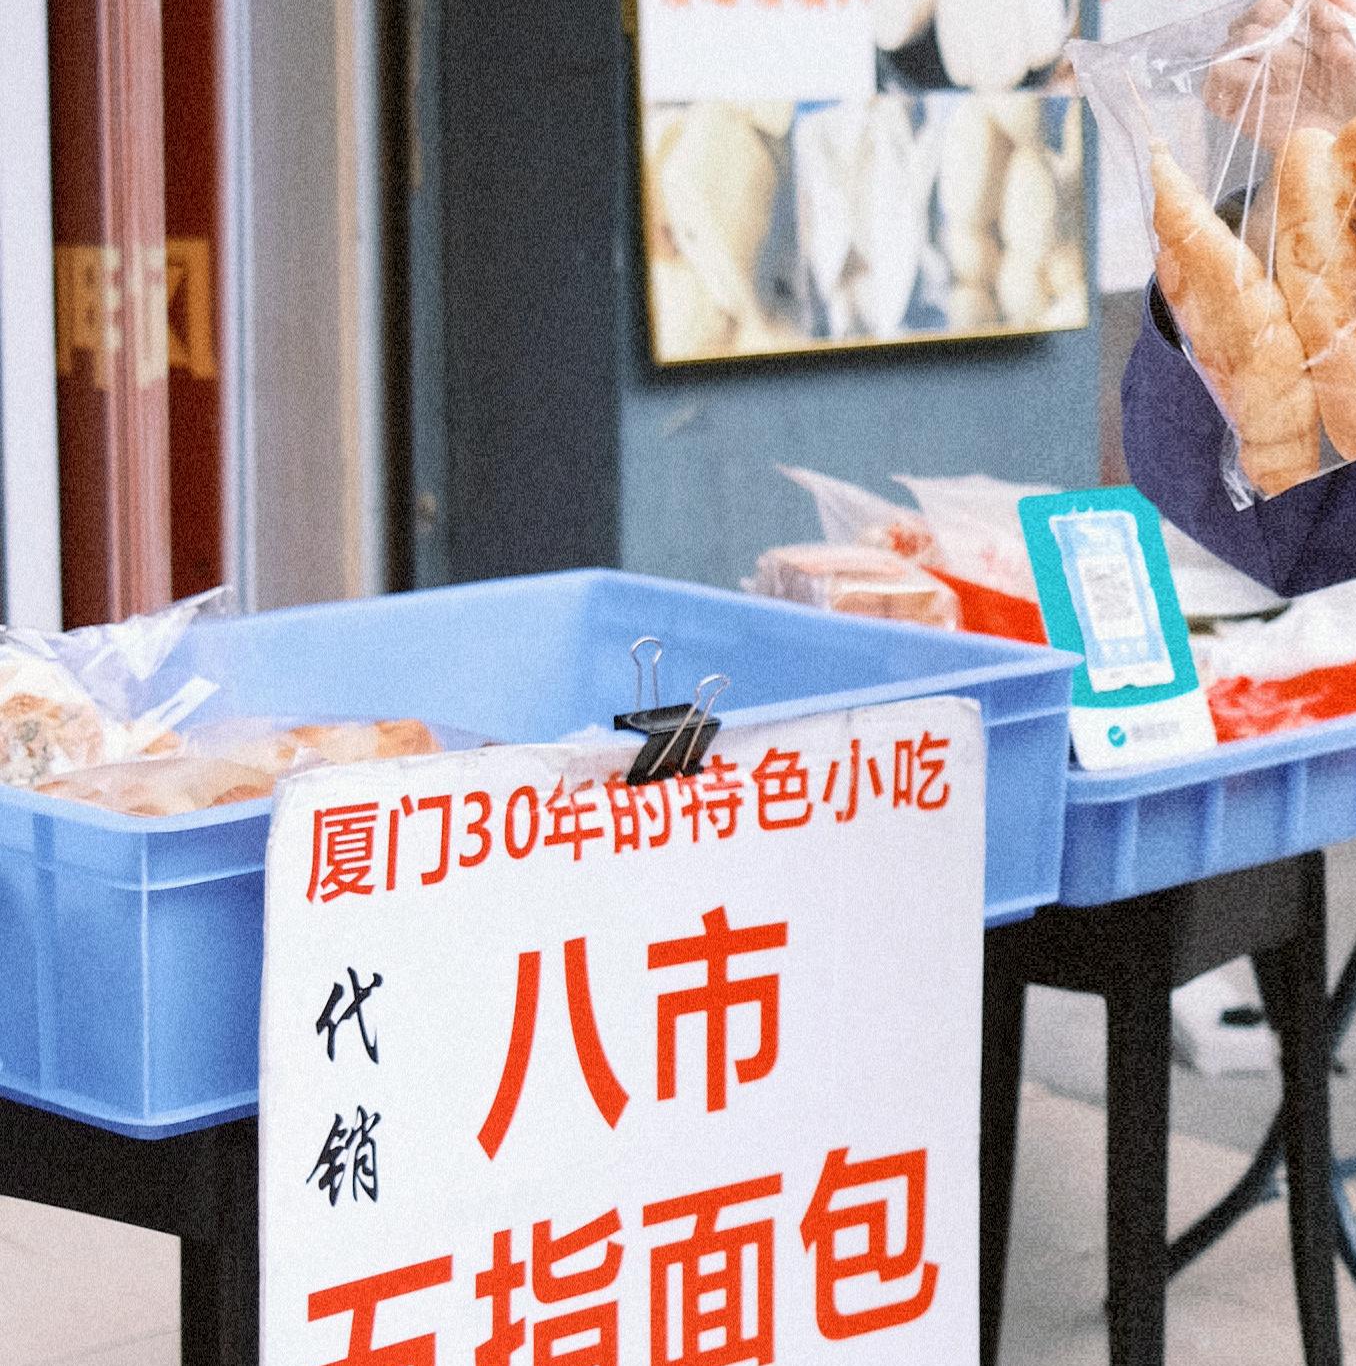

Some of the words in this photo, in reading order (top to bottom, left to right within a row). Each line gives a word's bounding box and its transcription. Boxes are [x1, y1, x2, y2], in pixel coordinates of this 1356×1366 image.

[306, 731, 951, 905] 厦门30年的特色小吃
[306, 966, 384, 1208] 代销
[476, 904, 789, 1162] 八市
